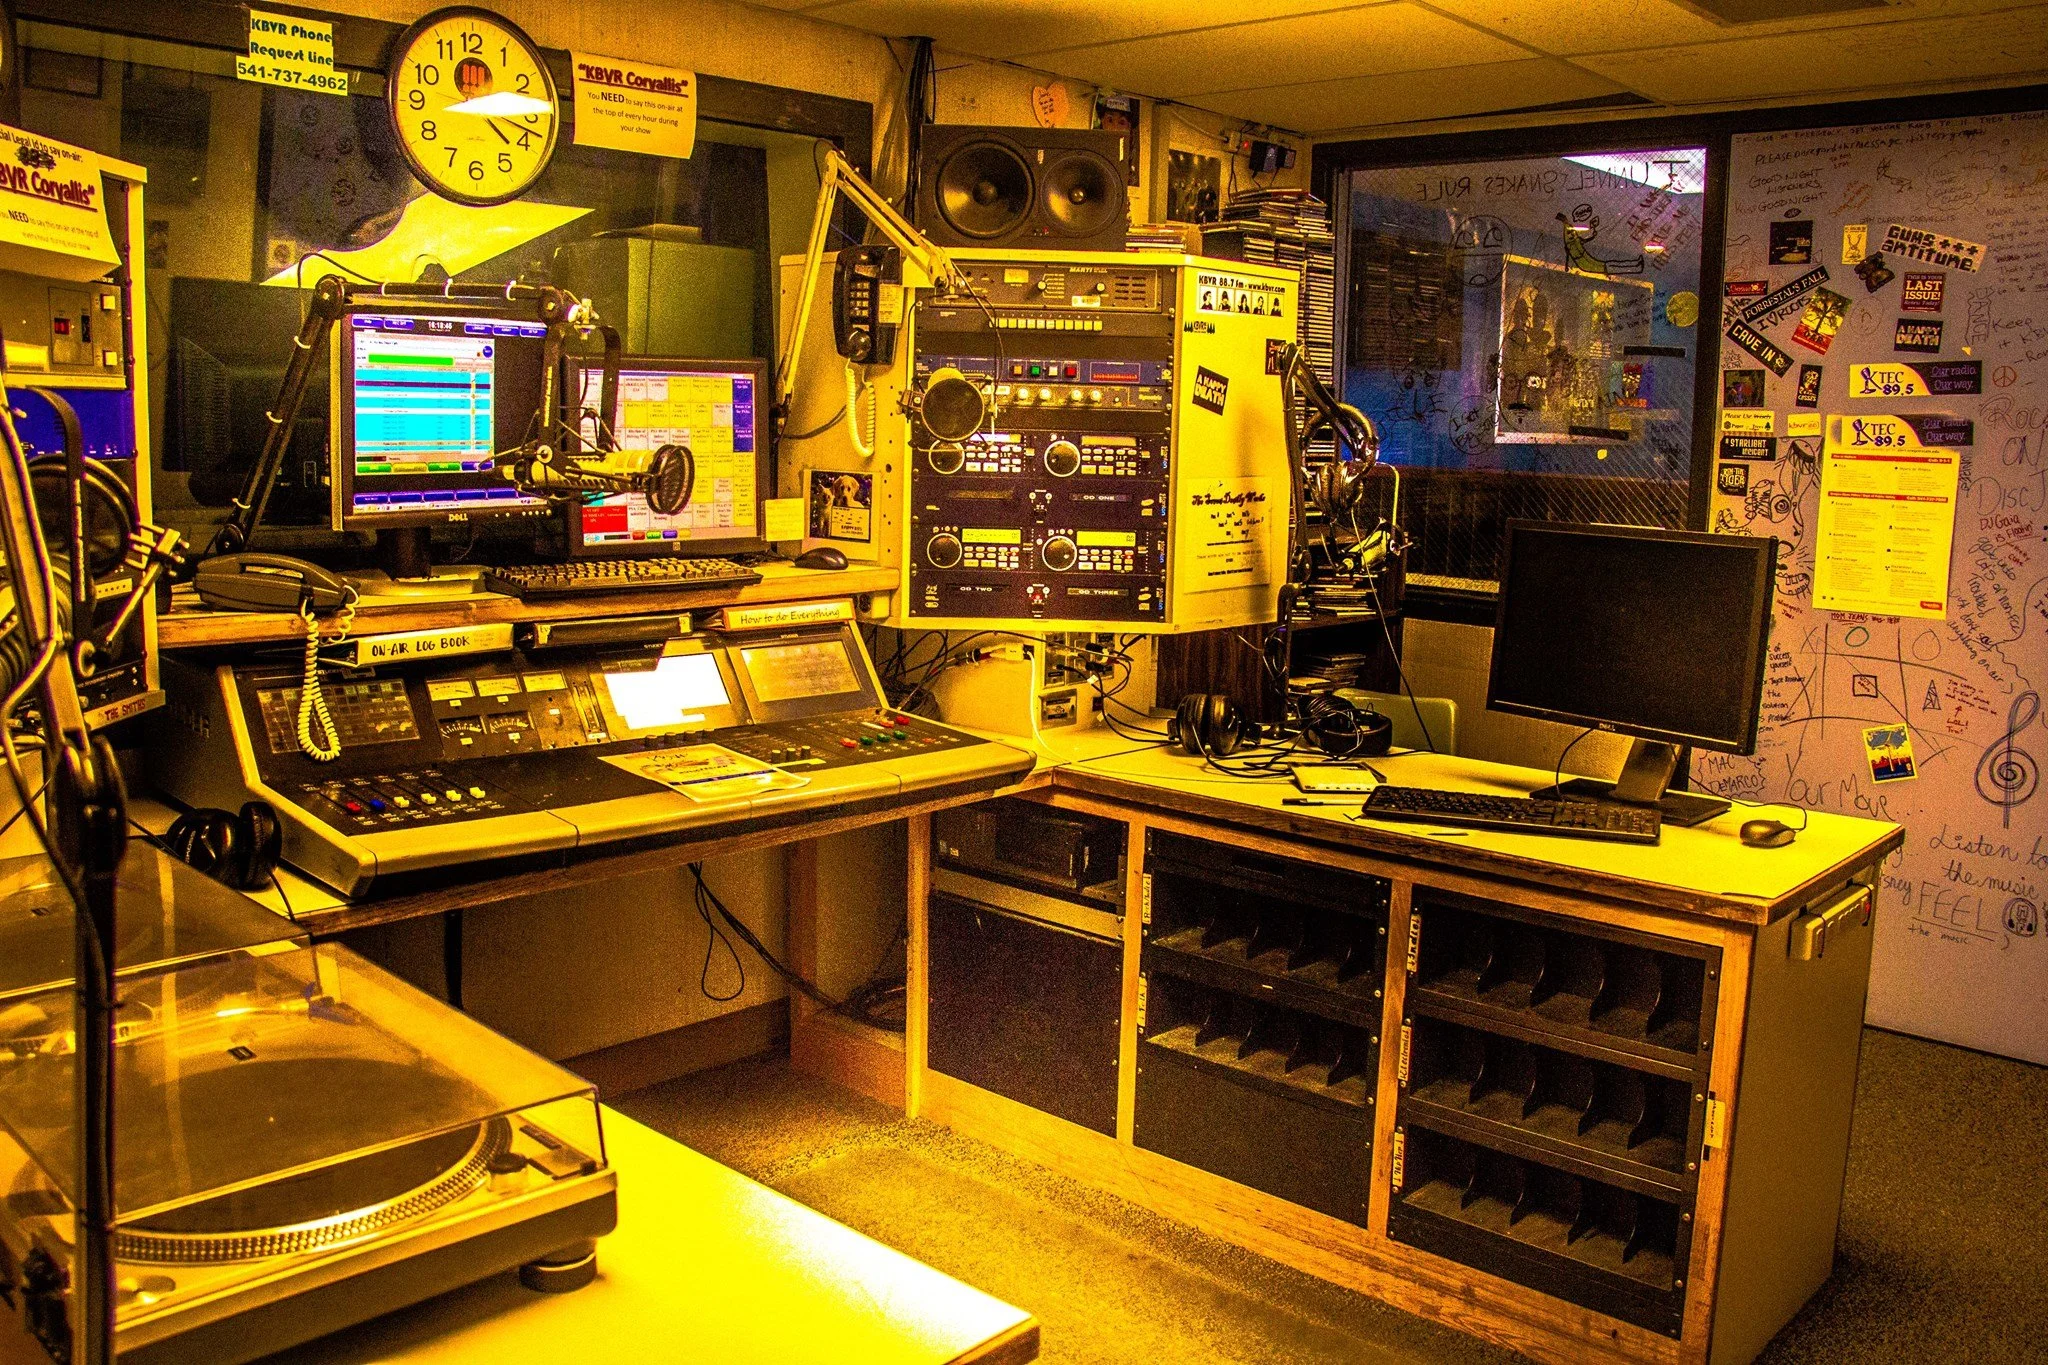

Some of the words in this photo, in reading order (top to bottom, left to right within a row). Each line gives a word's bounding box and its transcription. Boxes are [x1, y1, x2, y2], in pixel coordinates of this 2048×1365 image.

[251, 18, 287, 35] KBVR
[291, 25, 332, 42] Phone
[250, 41, 304, 61] Request
[308, 51, 333, 66] Line
[437, 39, 453, 61] 11
[460, 31, 483, 55] 12
[500, 46, 507, 68] 1
[237, 62, 347, 91] 541-737-4962
[415, 63, 439, 85] 10
[516, 74, 530, 94] 2
[409, 89, 425, 110] 9
[587, 91, 600, 100] You
[601, 92, 625, 103] NEED
[644, 101, 656, 109] this
[657, 103, 675, 111] on-air
[593, 107, 603, 115] the
[618, 110, 624, 118] of
[625, 113, 641, 121] every
[642, 115, 657, 123] hour
[658, 117, 679, 128] during
[421, 120, 437, 141] 8
[516, 131, 531, 151] 4
[636, 126, 651, 135] show
[12, 132, 30, 147] Legal
[40, 143, 48, 153] to
[49, 146, 61, 158] say
[443, 147, 458, 168] 7
[497, 152, 513, 173] 5
[468, 160, 484, 181] 6
[8, 209, 29, 224] NEED
[1199, 275, 1217, 285] KBVR
[1219, 277, 1234, 287] 88.7
[1235, 279, 1244, 288] fm
[1906, 280, 1942, 291] LAST
[1745, 283, 1800, 319] FORRESTAL'S
[1801, 271, 1825, 288] FALL
[1905, 291, 1941, 301] ISSUE!
[1896, 334, 1939, 345] DEATH
[1907, 325, 1940, 335] HAPPY
[1732, 324, 1762, 352] CAVE
[1760, 346, 1776, 362] IN
[1931, 367, 1949, 377] Our
[1204, 375, 1226, 392] HAPPY
[1882, 384, 1914, 395] 89.5
[1935, 381, 1951, 391] Our
[1195, 383, 1224, 406] DEATH
[1874, 436, 1906, 447] 89.5
[449, 514, 468, 522] DELL
[1980, 518, 1994, 531] DJ
[740, 614, 763, 625] How
[764, 613, 773, 623] to
[776, 611, 788, 622] do
[790, 609, 840, 622] Everything
[1848, 613, 1868, 621] JEANS
[371, 643, 410, 657] ON-AIR
[416, 640, 435, 652] LOG
[440, 635, 471, 650] BOOK
[104, 706, 119, 721] THE
[122, 699, 146, 717] SMITHS
[1709, 754, 1735, 774] MAC
[1930, 824, 2018, 862] Listen
[2026, 836, 2048, 870] to
[1942, 860, 1983, 887] the
[1977, 877, 2039, 900] music
[1918, 881, 1999, 934] FEEL
[1941, 933, 1968, 945] music
